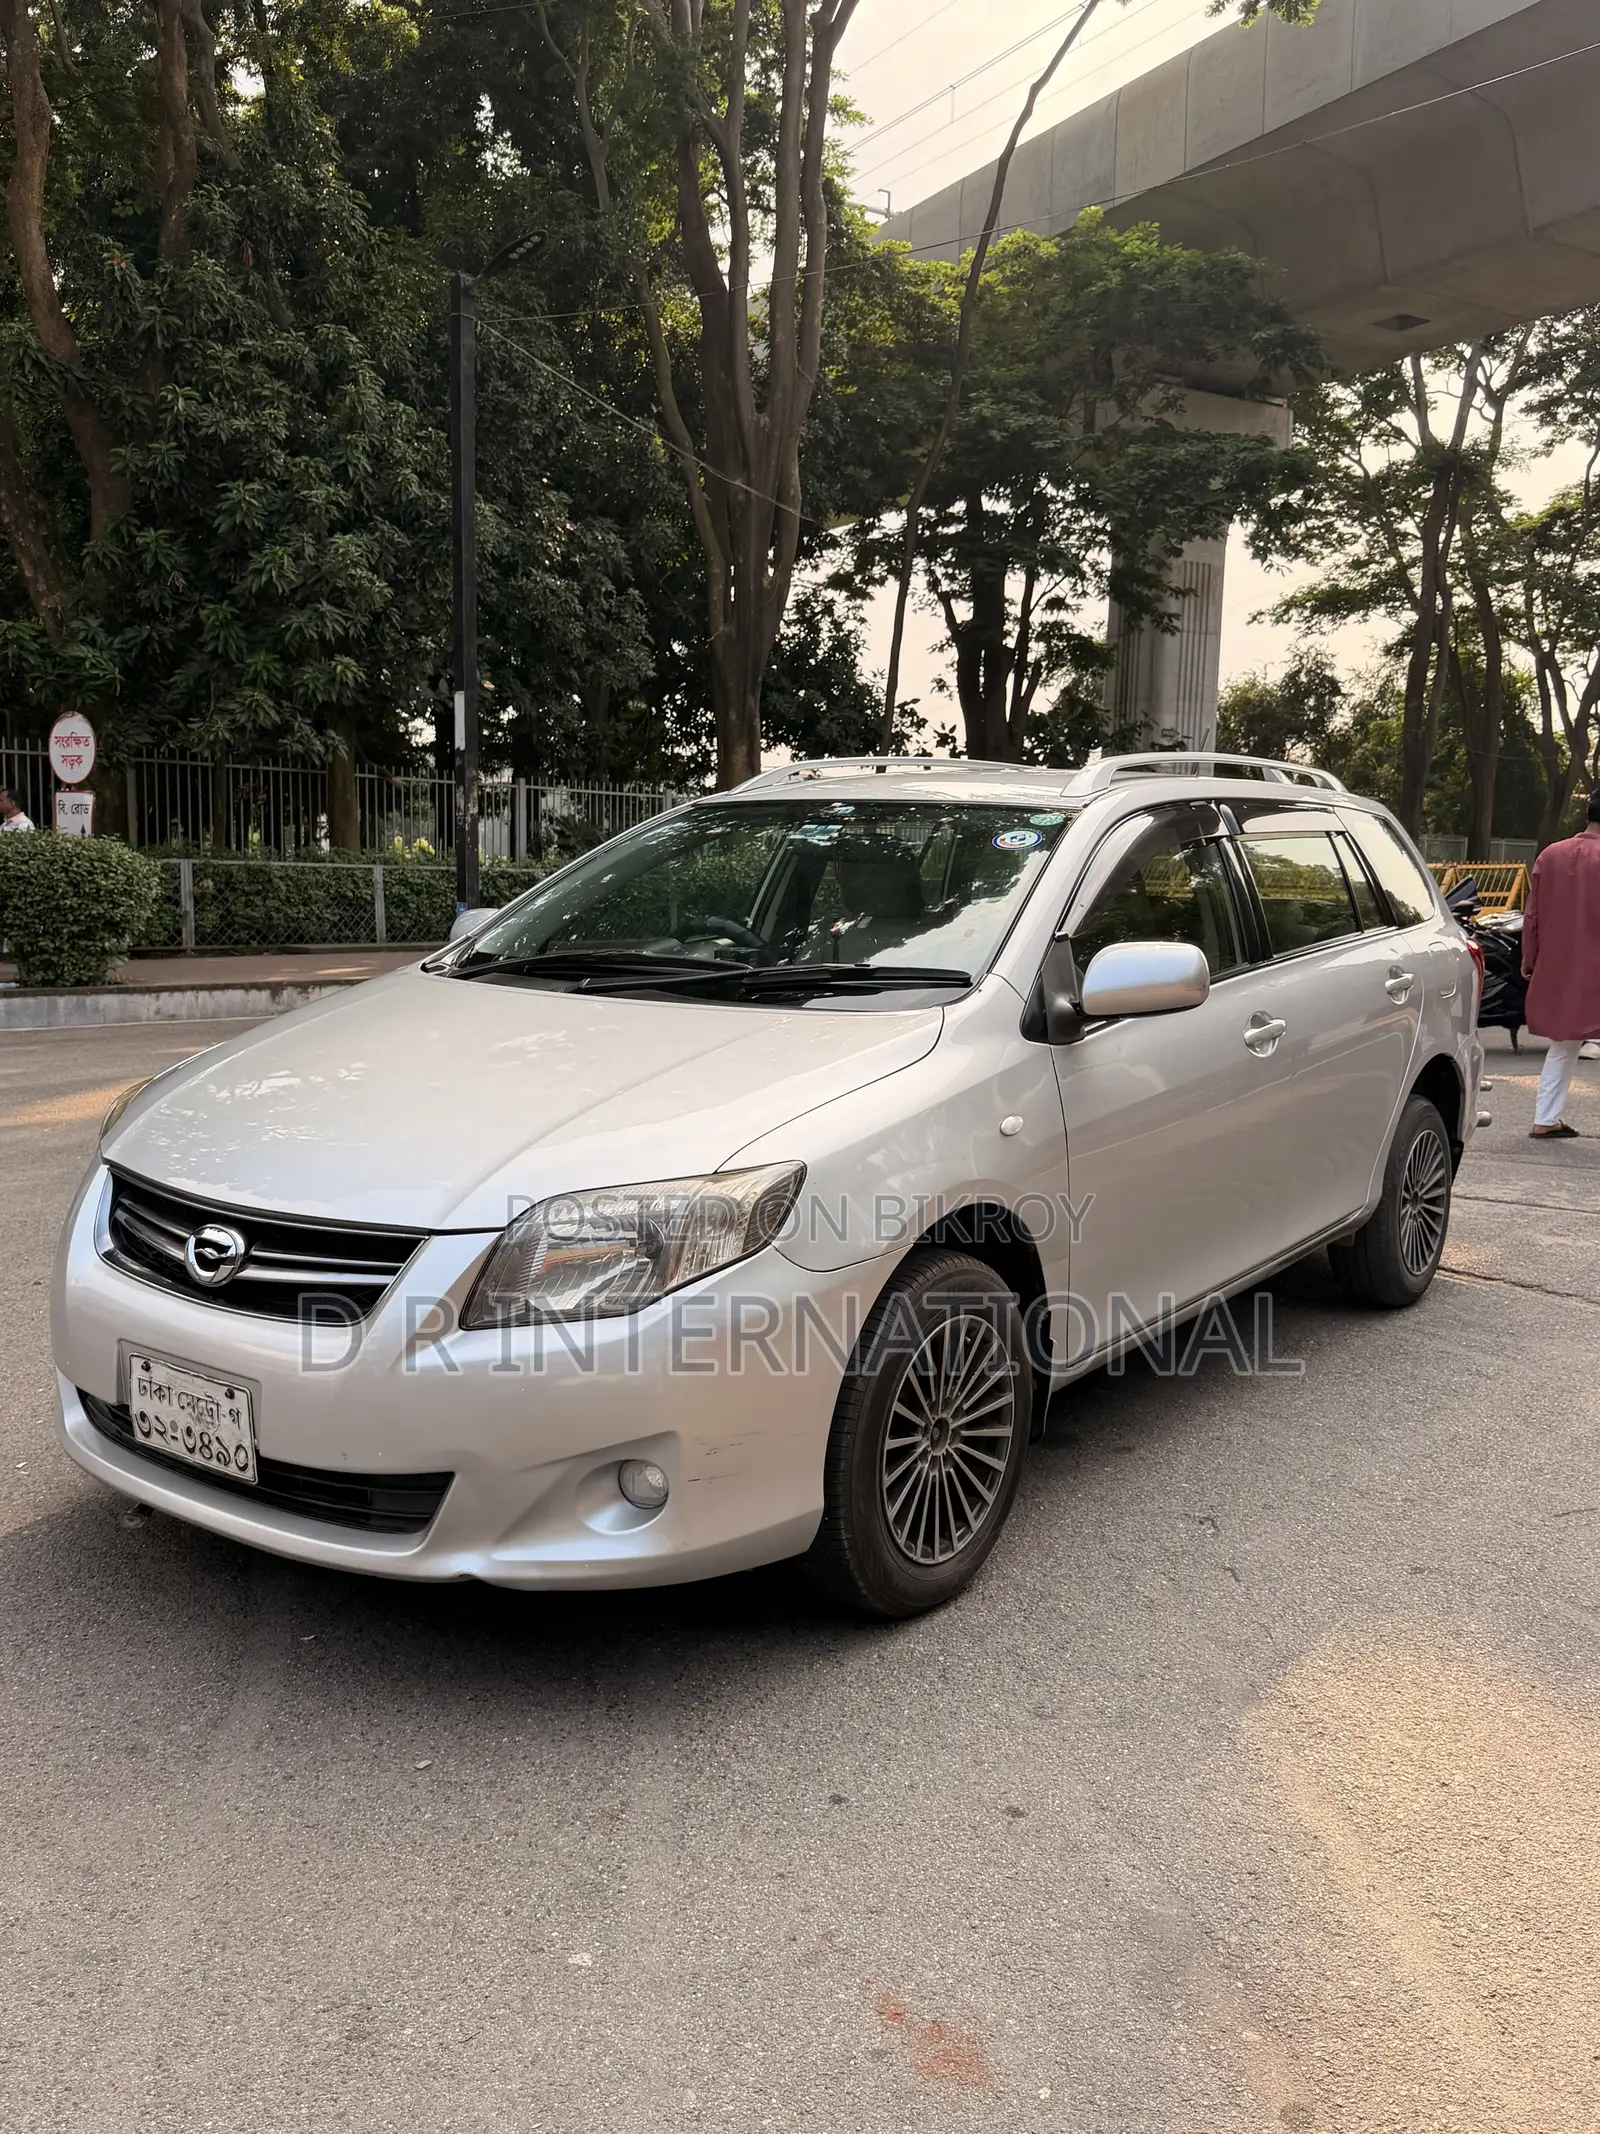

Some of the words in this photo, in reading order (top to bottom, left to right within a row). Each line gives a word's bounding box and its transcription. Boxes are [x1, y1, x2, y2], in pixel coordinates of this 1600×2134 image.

[54, 732, 91, 749] সংরক্ষিত
[60, 754, 84, 770] সড়ক
[70, 803, 91, 815] রোড
[137, 1376, 173, 1407] ঢাকা
[134, 1409, 250, 1473] ৩২-৩৪৯০
